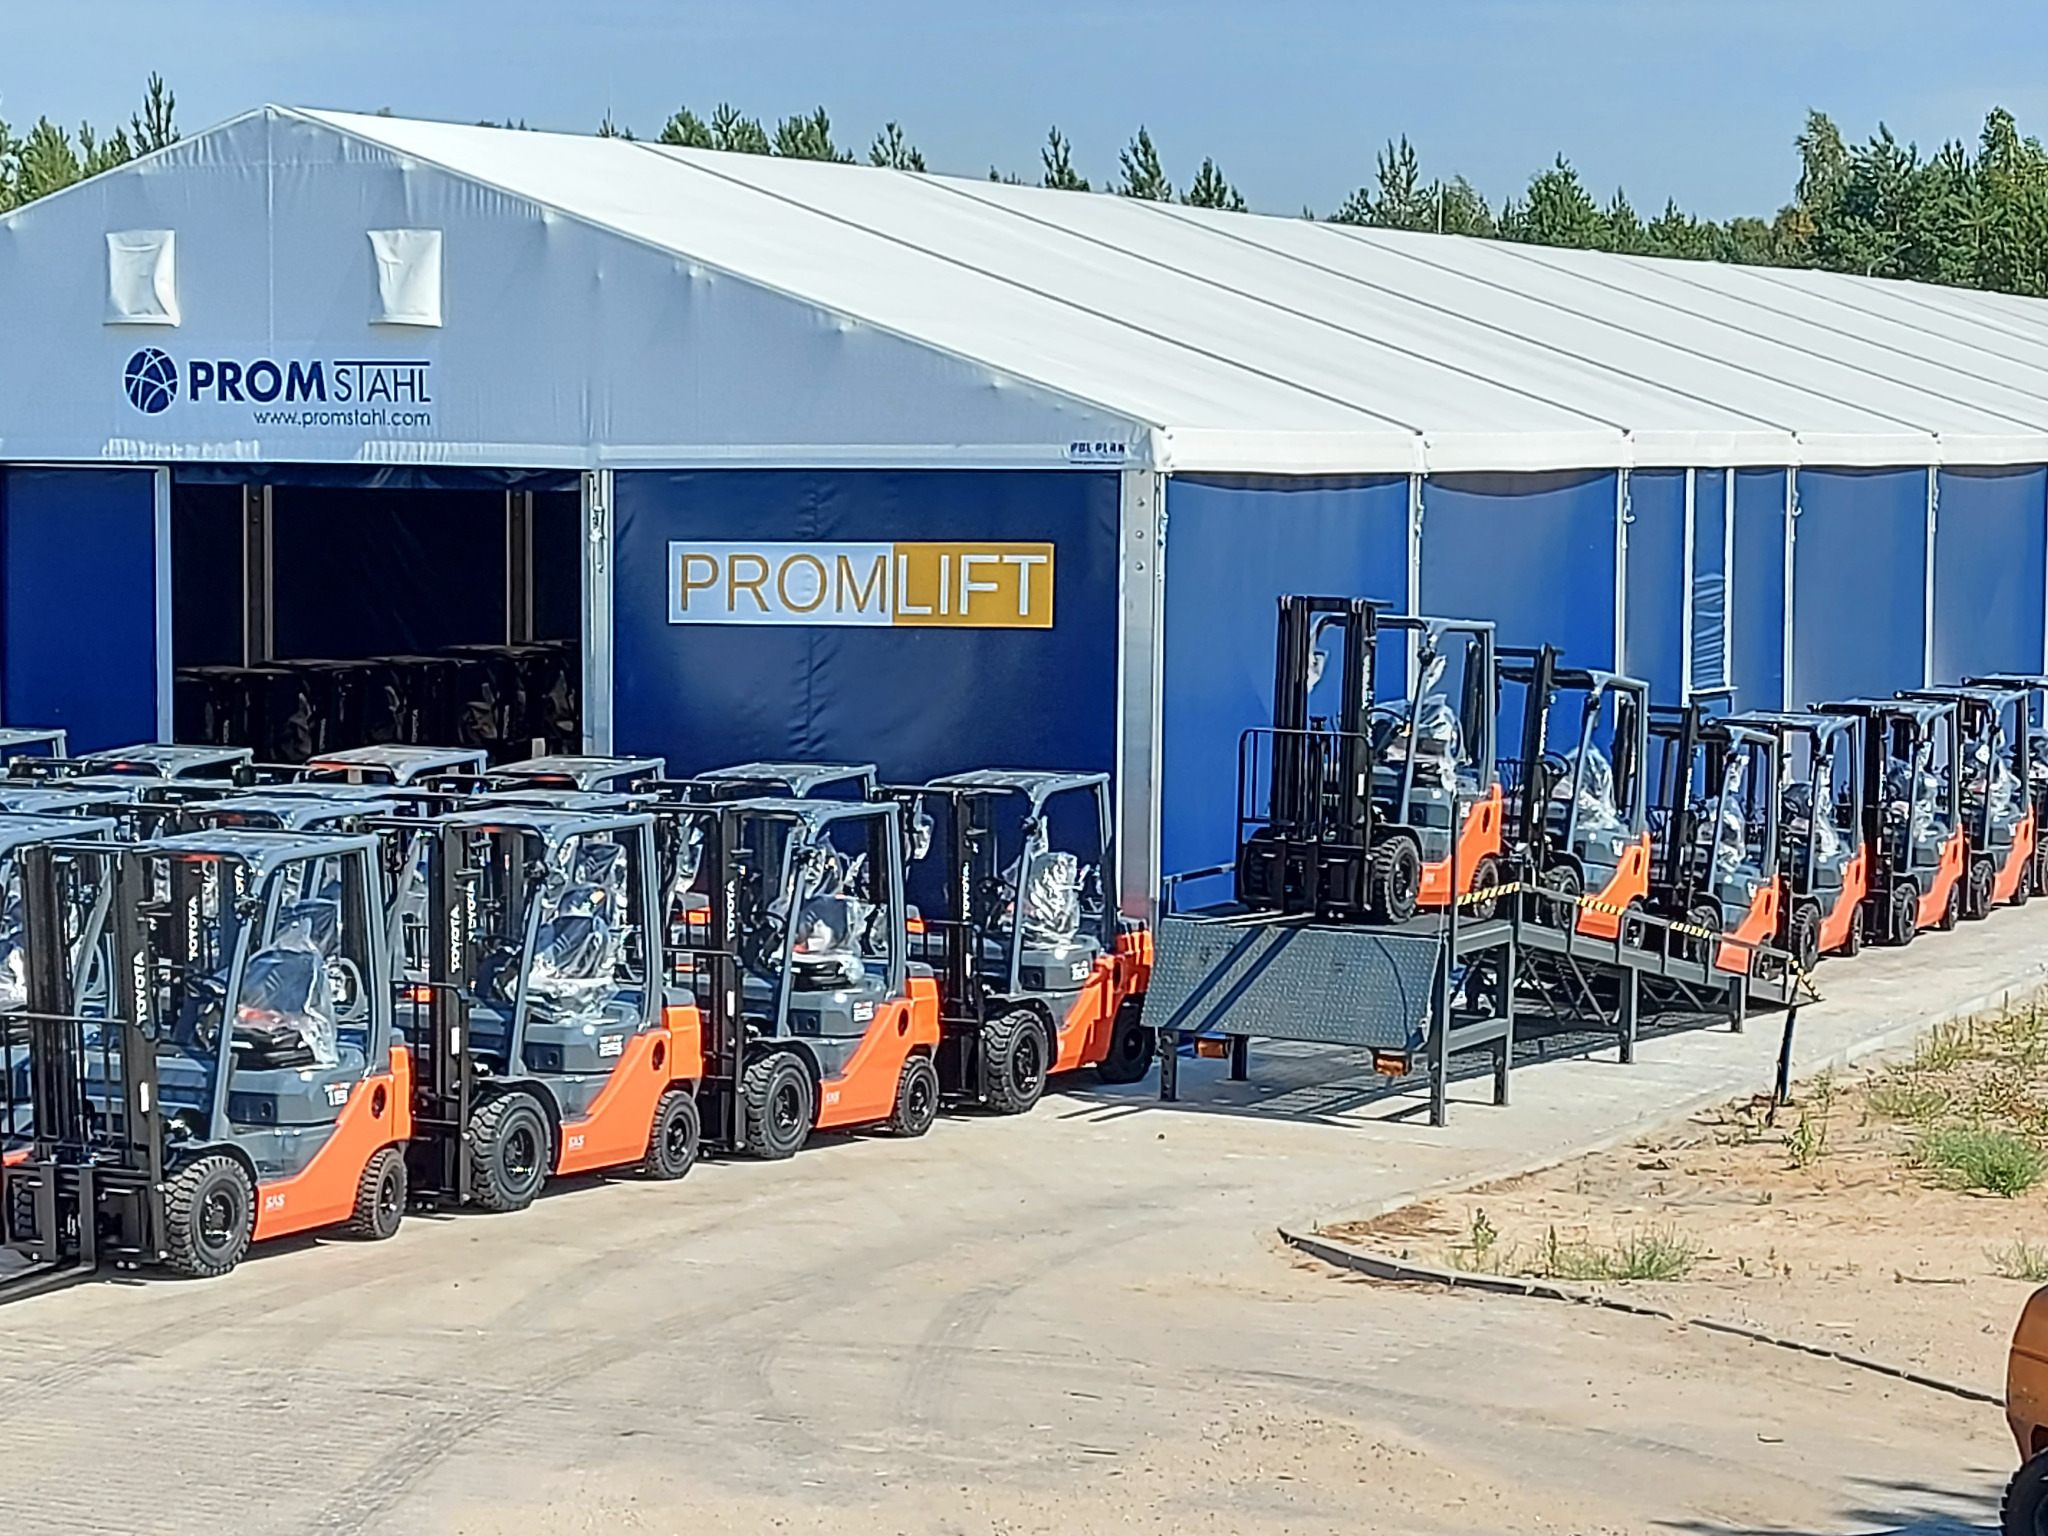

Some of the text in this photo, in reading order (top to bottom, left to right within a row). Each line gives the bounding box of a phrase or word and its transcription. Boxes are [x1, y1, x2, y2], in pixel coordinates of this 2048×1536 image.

[254, 409, 431, 428] www.promstahl.com
[188, 895, 199, 962] TOYOTA
[450, 904, 462, 974] TOYOTA
[134, 951, 148, 1026] TOYOTA
[264, 1194, 286, 1209] SAS
